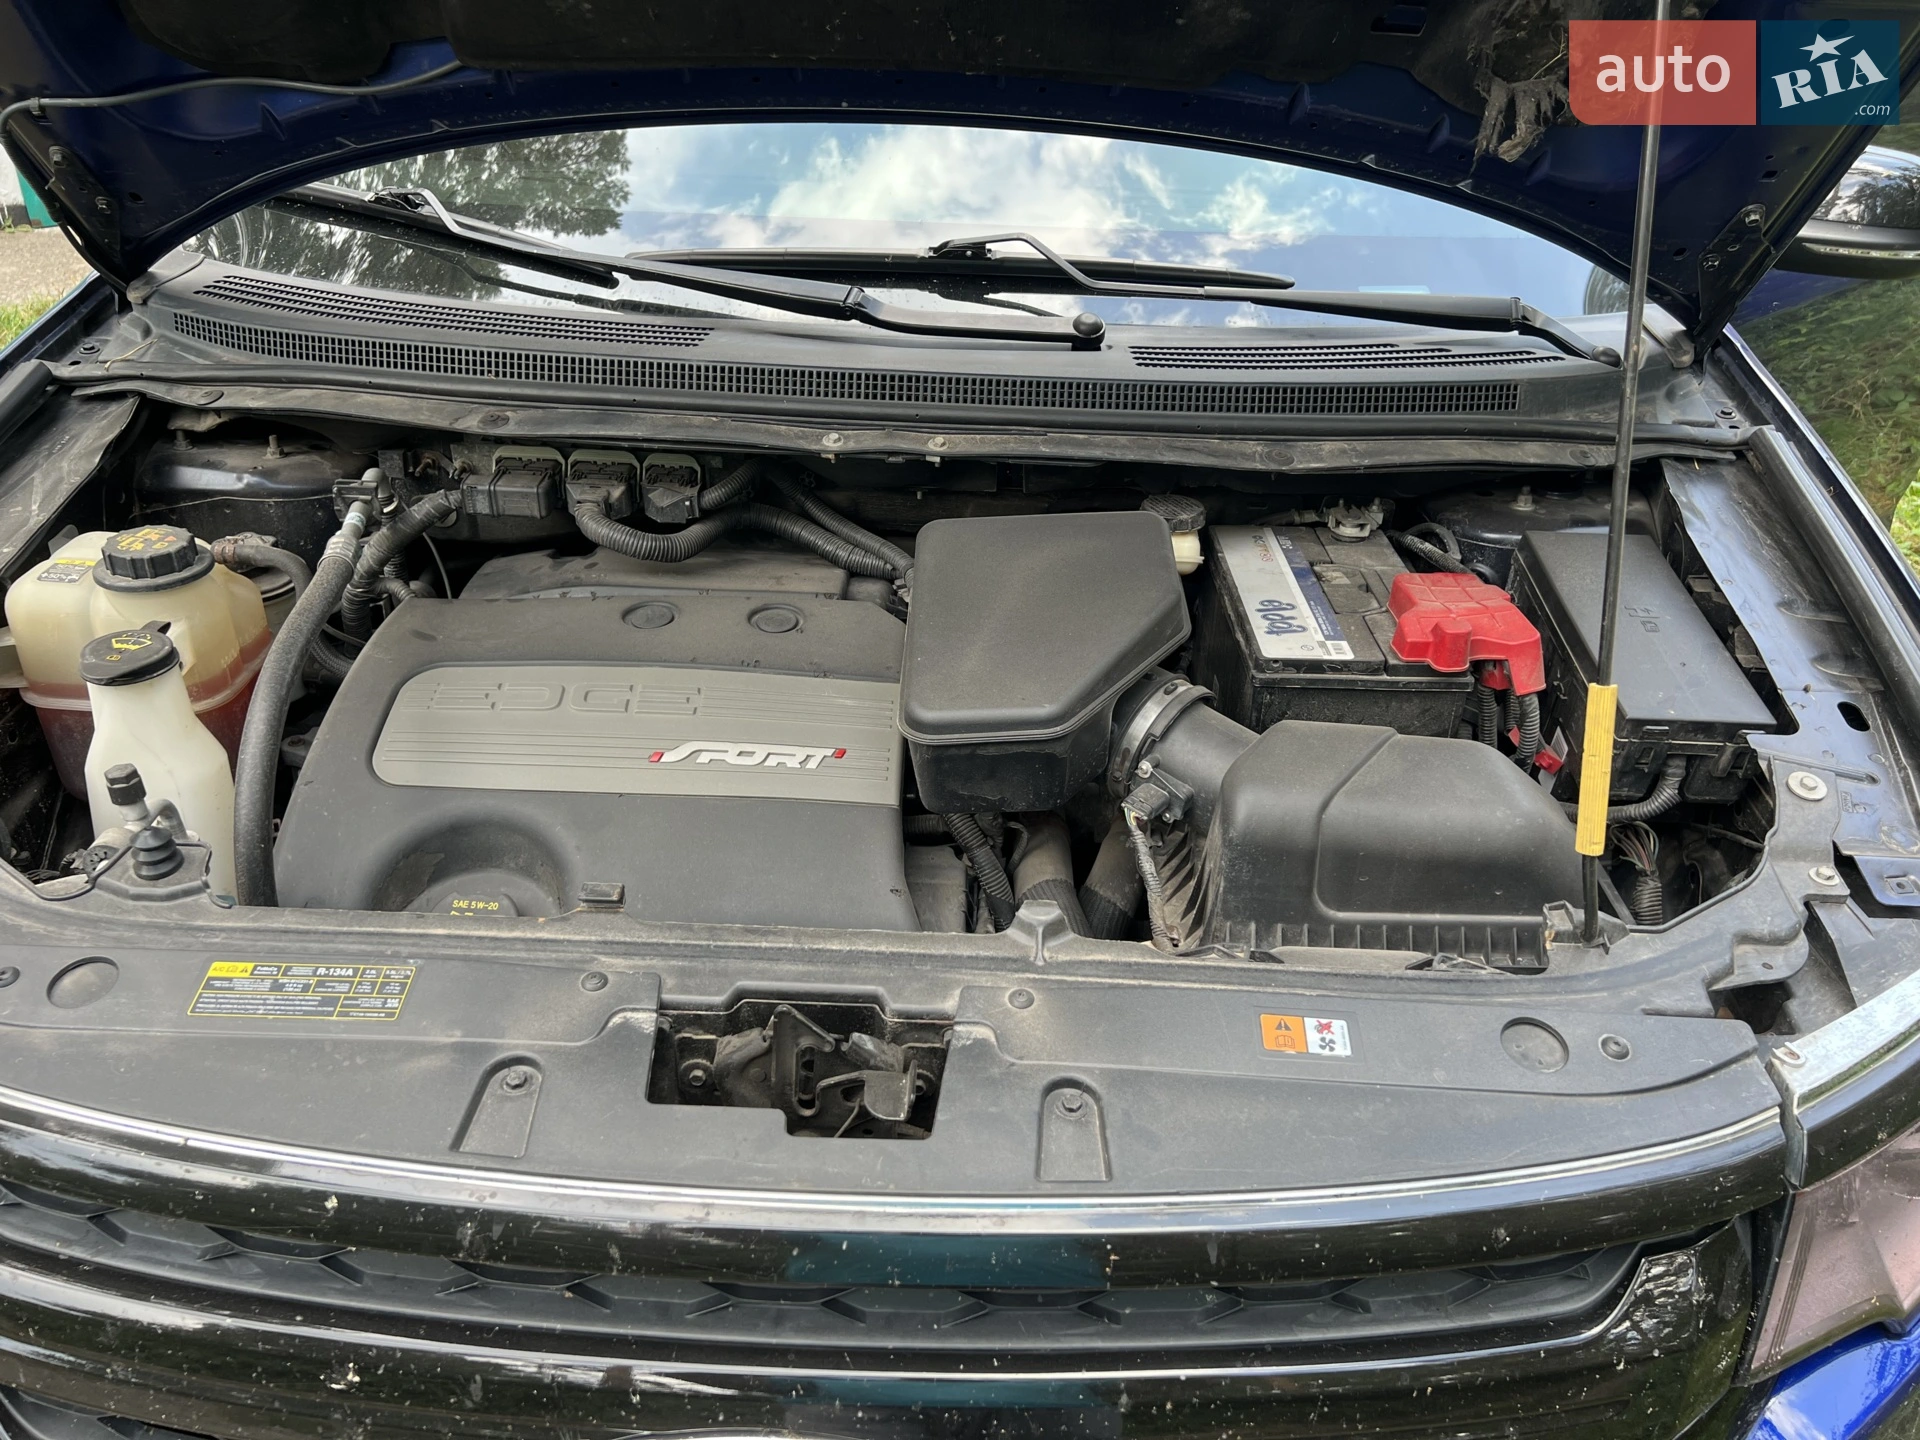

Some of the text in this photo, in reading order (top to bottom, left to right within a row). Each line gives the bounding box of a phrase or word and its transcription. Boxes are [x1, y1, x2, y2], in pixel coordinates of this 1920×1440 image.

[432, 682, 702, 716] EDGE
[659, 740, 836, 769] SPORT
[452, 899, 499, 911] SAE 5W-20
[316, 967, 354, 976] R-134A
